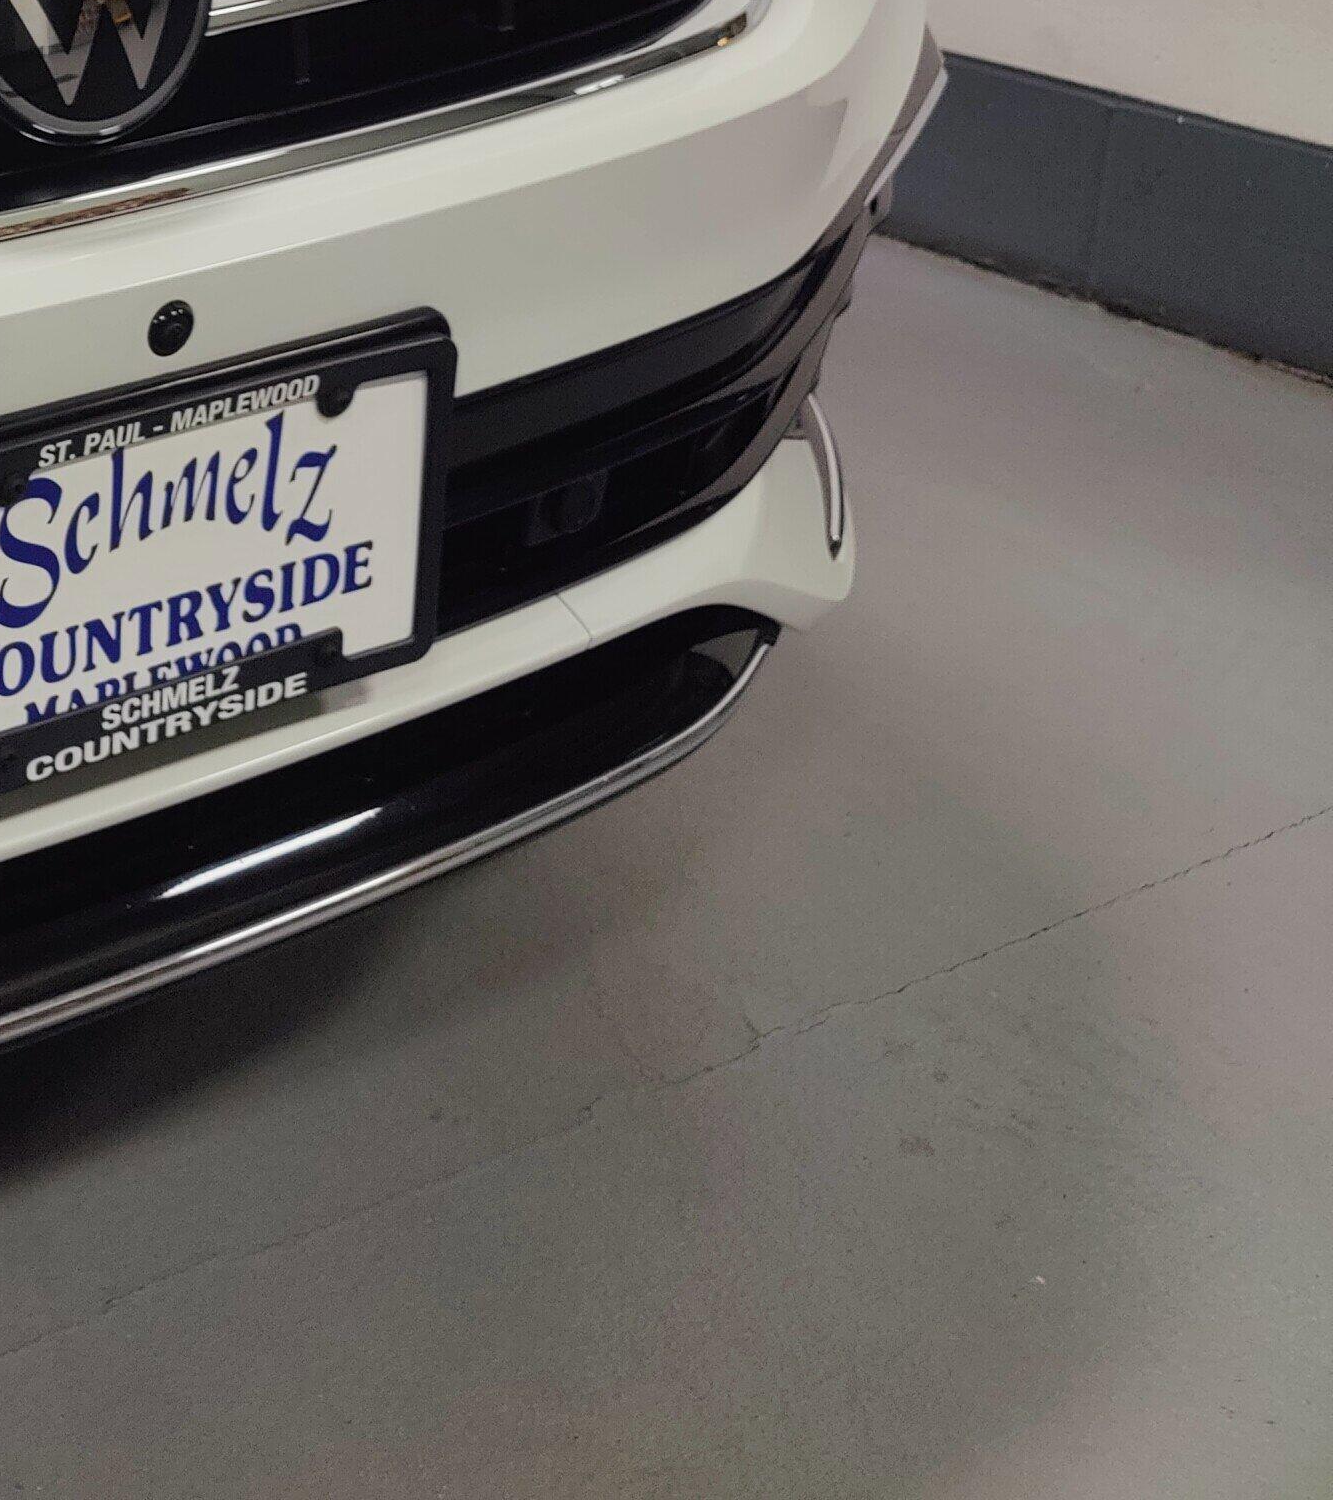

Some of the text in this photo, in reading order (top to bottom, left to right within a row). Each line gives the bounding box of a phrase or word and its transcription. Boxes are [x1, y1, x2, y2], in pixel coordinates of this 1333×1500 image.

[38, 439, 76, 468] ST.
[83, 421, 145, 456] PAUL
[170, 374, 321, 432] MAPLEWOOD
[25, 671, 309, 782] COUNTRYSIDE
[101, 665, 240, 731] SCHMELZ
